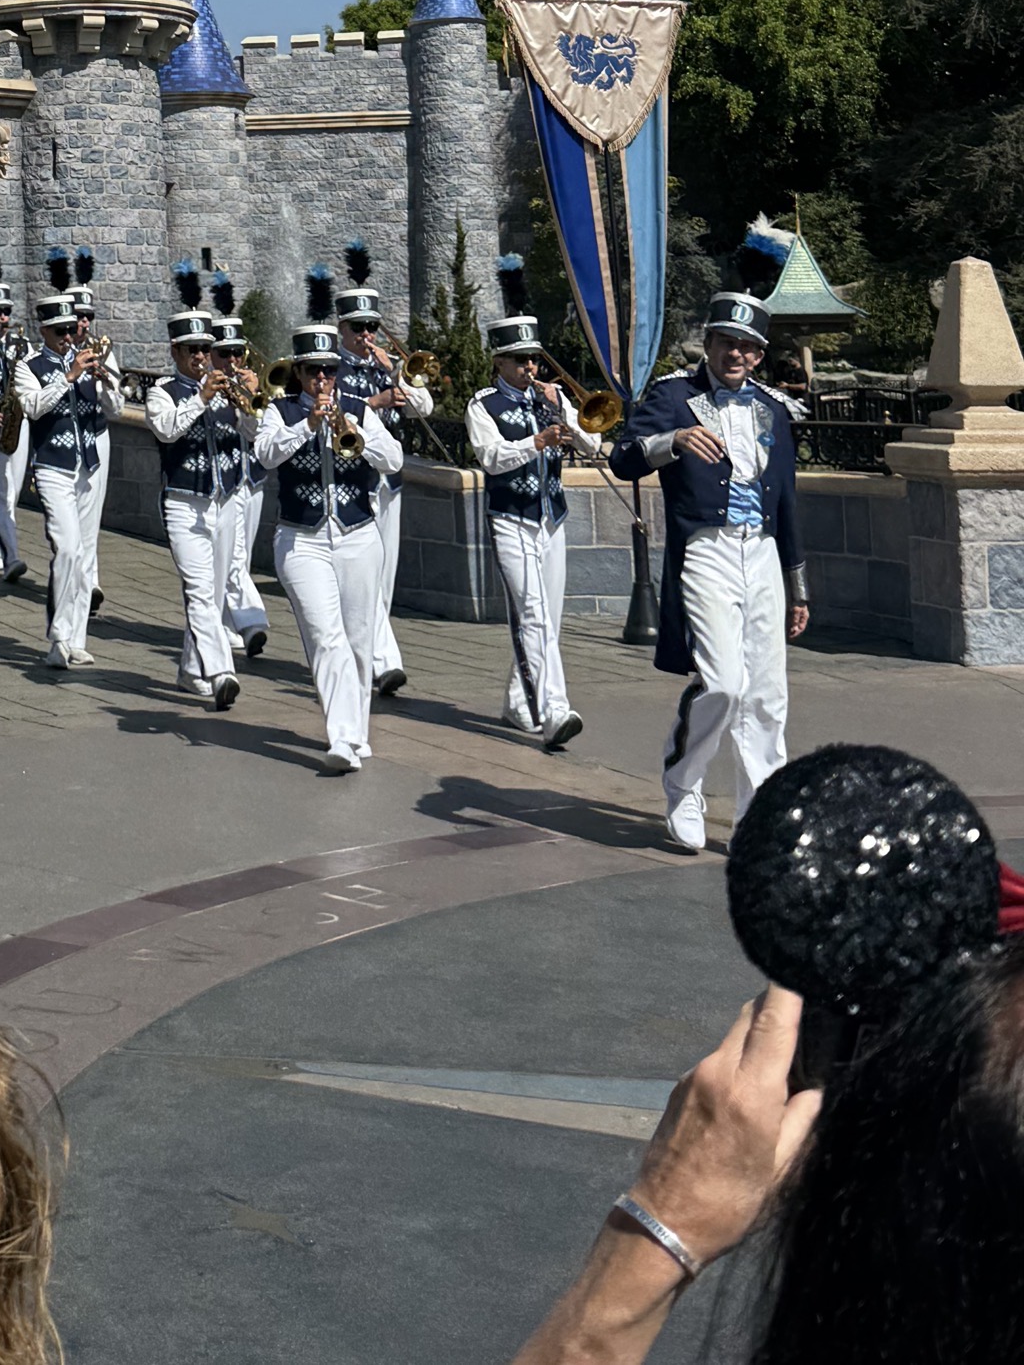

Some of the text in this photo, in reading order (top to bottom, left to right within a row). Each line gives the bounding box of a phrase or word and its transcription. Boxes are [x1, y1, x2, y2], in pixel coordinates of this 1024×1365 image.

[358, 296, 370, 310] D
[732, 302, 753, 323] D
[190, 319, 204, 332] D
[224, 326, 236, 338] D
[519, 325, 532, 340] D
[315, 334, 331, 350] D
